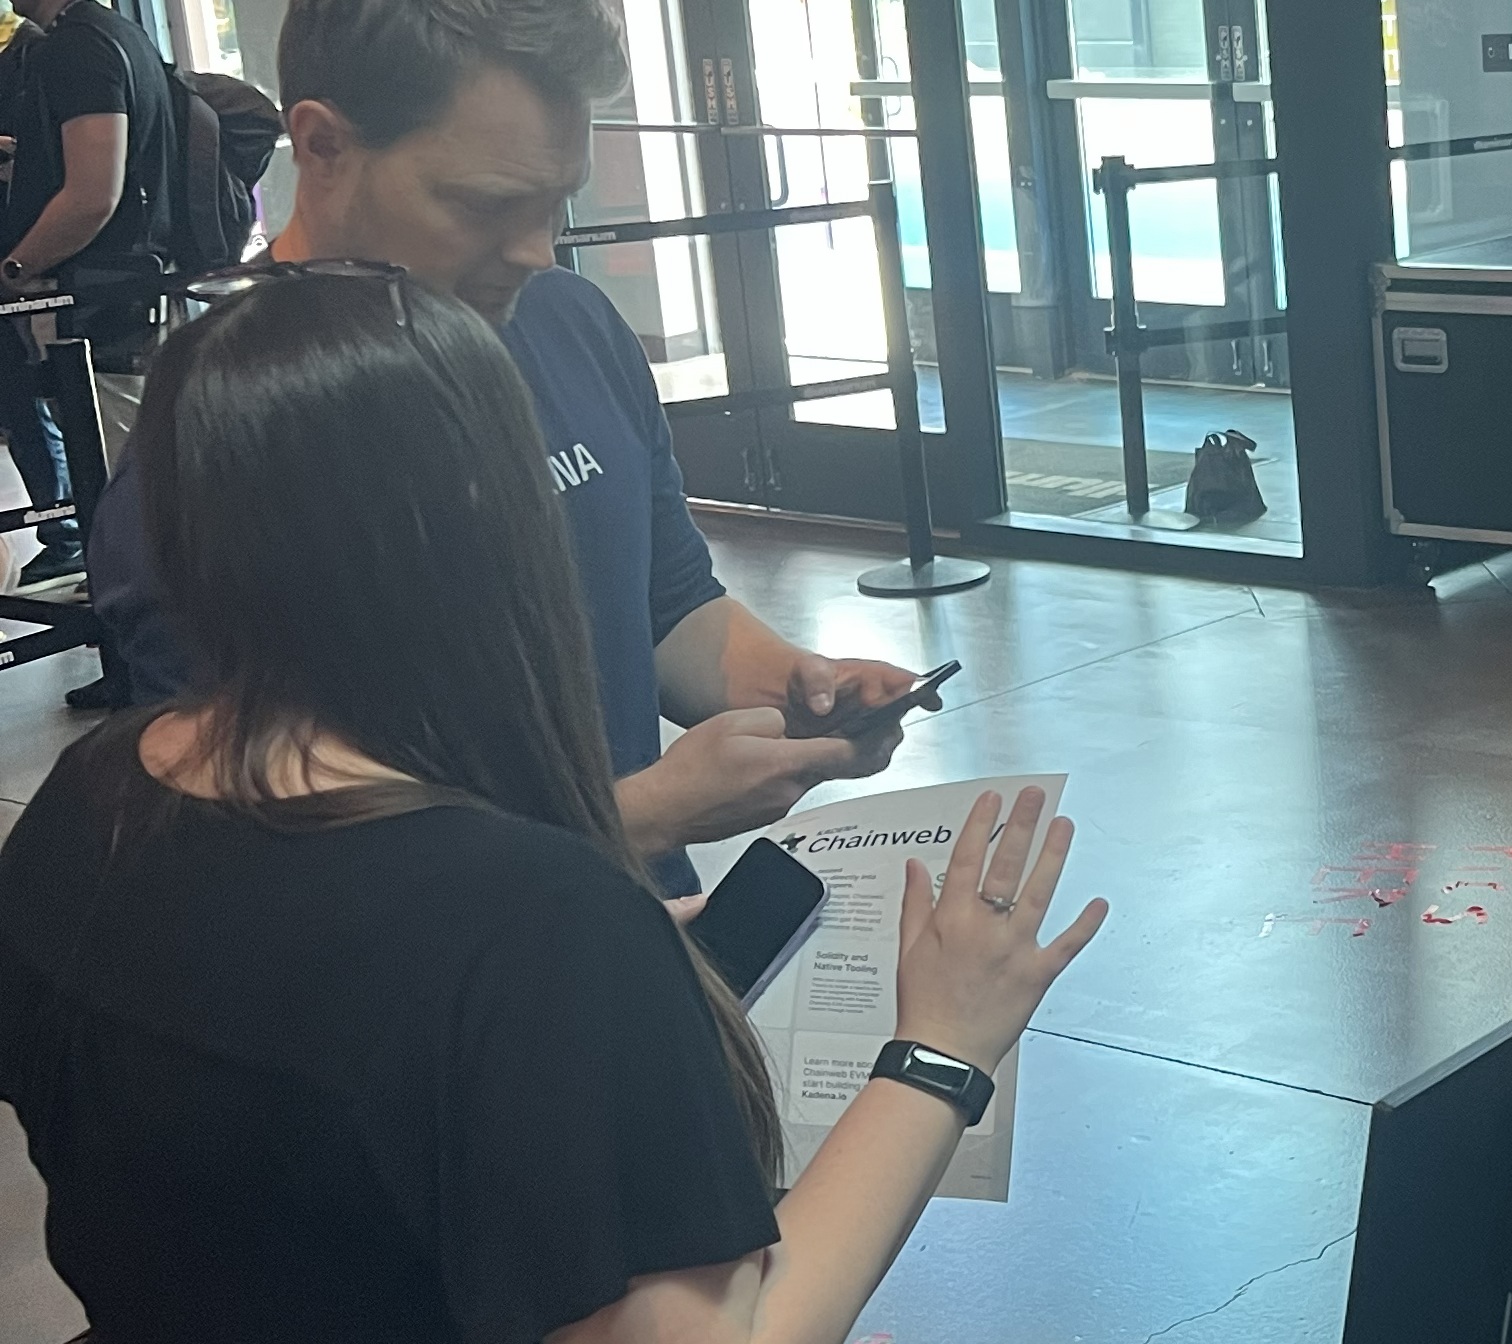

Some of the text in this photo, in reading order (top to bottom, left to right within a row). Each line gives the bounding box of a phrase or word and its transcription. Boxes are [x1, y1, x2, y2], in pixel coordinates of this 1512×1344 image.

[546, 442, 604, 495] NA
[808, 824, 953, 854] Chainweb
[850, 953, 869, 962] and
[813, 961, 878, 976] Native Tooling
[803, 1056, 830, 1067] Learn
[831, 1059, 854, 1068] more
[802, 1067, 848, 1079] Chainweb
[802, 1079, 861, 1092] start building
